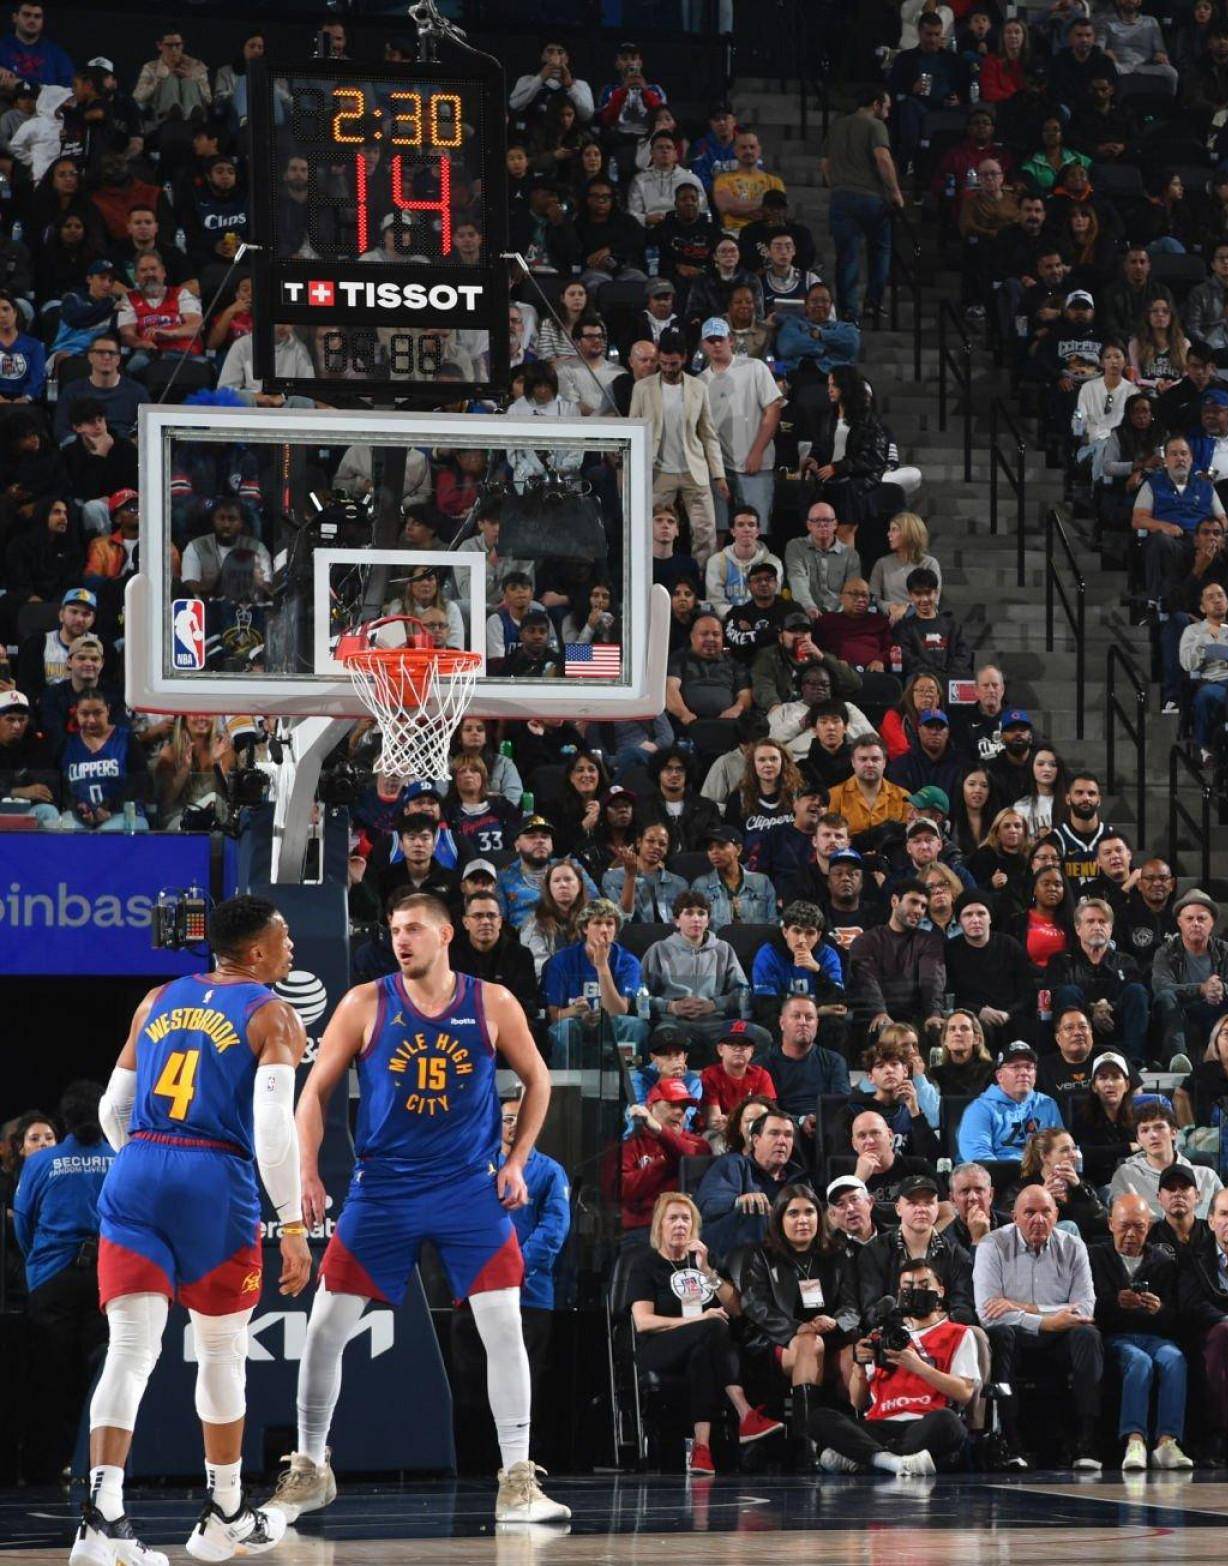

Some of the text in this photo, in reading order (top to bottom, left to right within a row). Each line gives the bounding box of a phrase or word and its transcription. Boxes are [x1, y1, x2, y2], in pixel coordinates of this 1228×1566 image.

[333, 88, 462, 146] 2:30
[357, 154, 452, 256] 14
[204, 212, 247, 230] Clips
[284, 281, 483, 311] T TISSOT
[176, 653, 195, 667] NBA
[69, 759, 119, 782] CLIPPERS
[89, 785, 103, 805] 0
[746, 814, 795, 831] Clippers
[479, 831, 503, 852] 33
[1065, 861, 1098, 878] DENV
[0, 882, 179, 927] inbas
[145, 1008, 241, 1053] WESTBROOK
[388, 1033, 474, 1075] MILE HIGH
[417, 1057, 447, 1090] 15
[154, 1050, 200, 1121] 4
[406, 1094, 449, 1115] CITY
[53, 1156, 117, 1167] SECURIT
